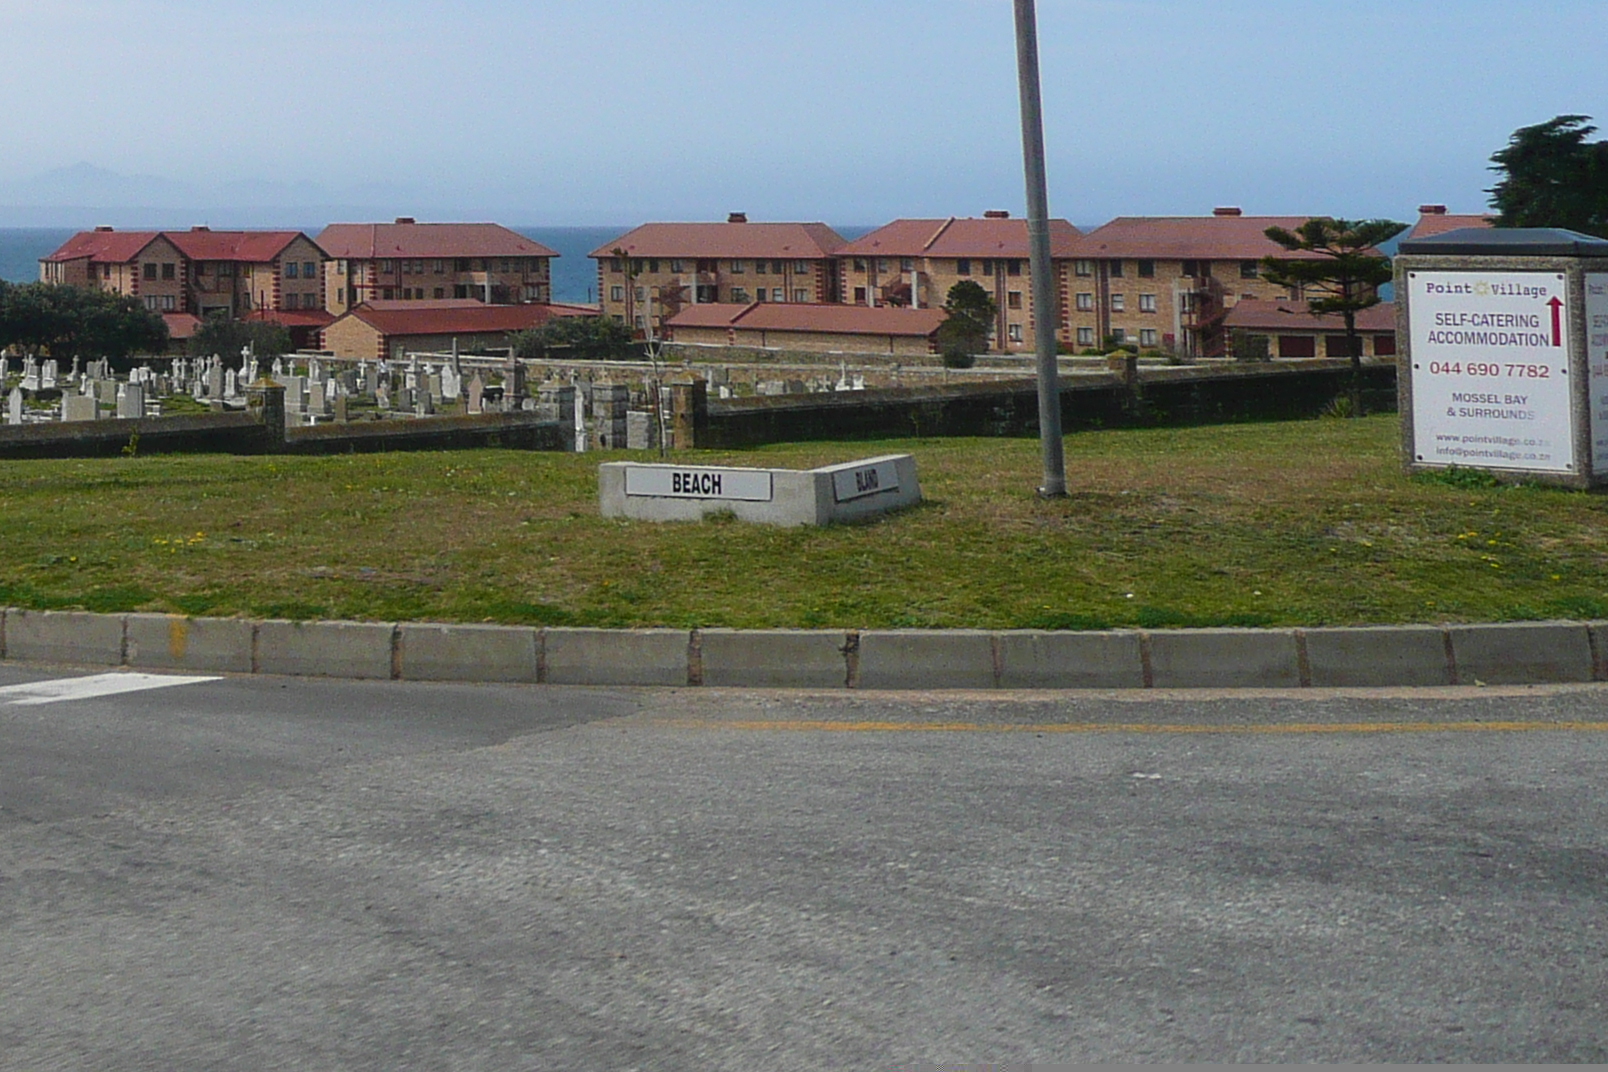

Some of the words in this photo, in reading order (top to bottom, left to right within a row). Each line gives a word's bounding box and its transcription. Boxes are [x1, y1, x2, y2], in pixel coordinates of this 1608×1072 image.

[1426, 282, 1473, 295] Point
[1492, 284, 1547, 299] Village
[1435, 313, 1539, 328] SELF-CATERING
[1428, 331, 1549, 347] ACCOMMODATION
[1430, 362, 1462, 375] 044
[1467, 363, 1500, 377] 690
[1505, 364, 1550, 378] 7782
[1452, 393, 1501, 405] MOSSEL
[1504, 395, 1528, 405] BAY
[1447, 407, 1456, 417] &
[1459, 408, 1535, 421] SURROUNDS
[672, 472, 722, 495] BEACH
